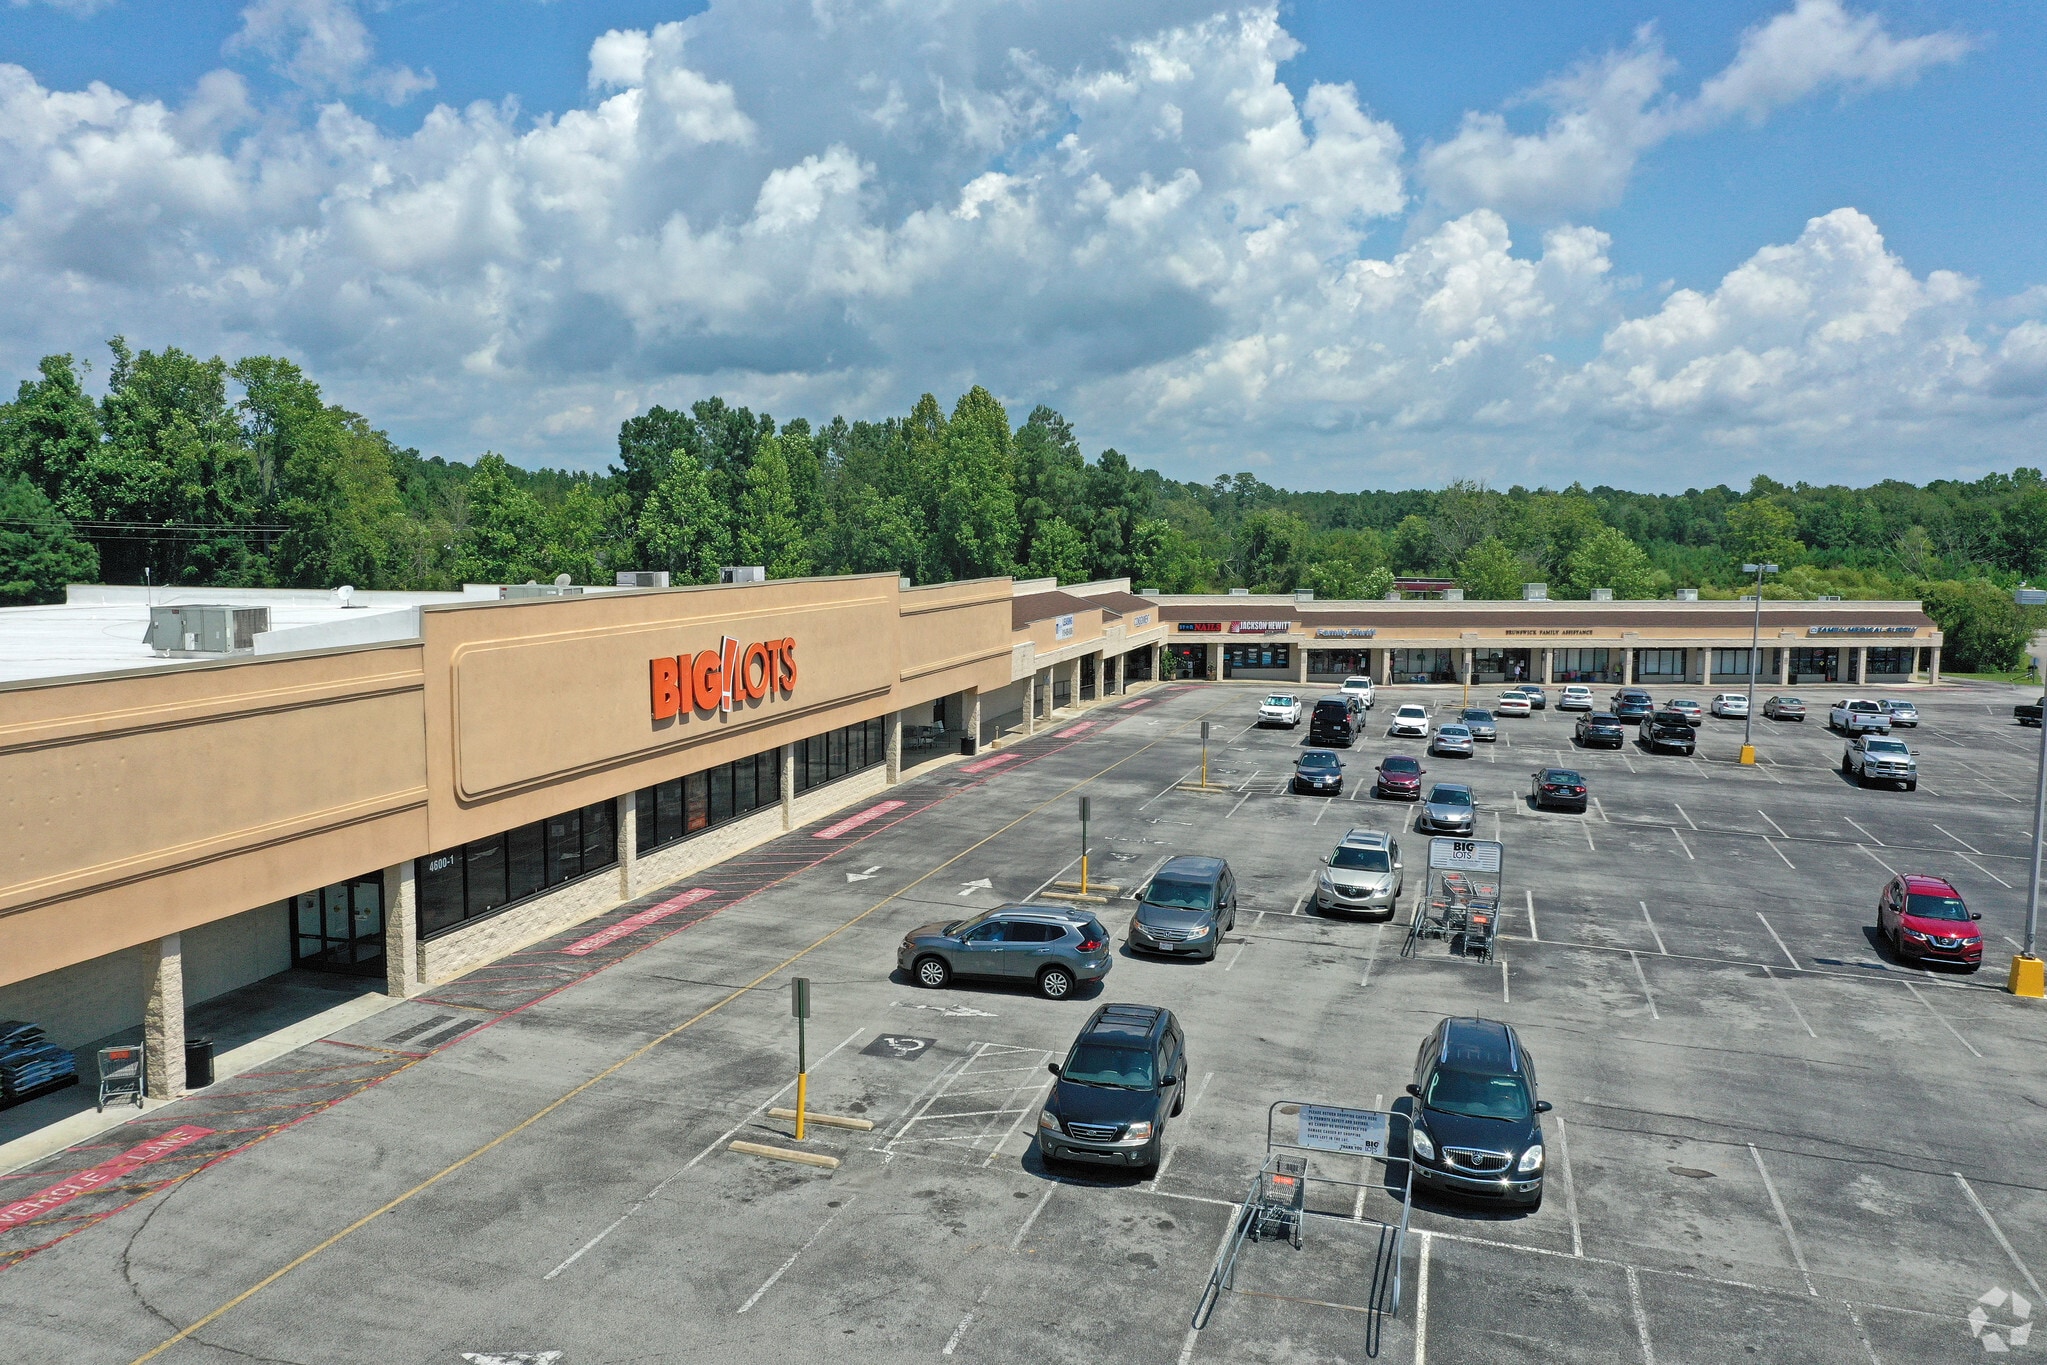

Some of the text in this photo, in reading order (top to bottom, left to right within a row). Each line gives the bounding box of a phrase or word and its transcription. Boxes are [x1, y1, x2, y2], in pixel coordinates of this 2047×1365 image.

[1240, 621, 1292, 630] JACKSON HEWITT
[1316, 628, 1349, 638] Family
[1454, 842, 1475, 851] BIG
[1453, 851, 1472, 860] LOTS
[429, 854, 454, 872] 4600-1
[0, 1131, 193, 1222] VEHICLE LANE
